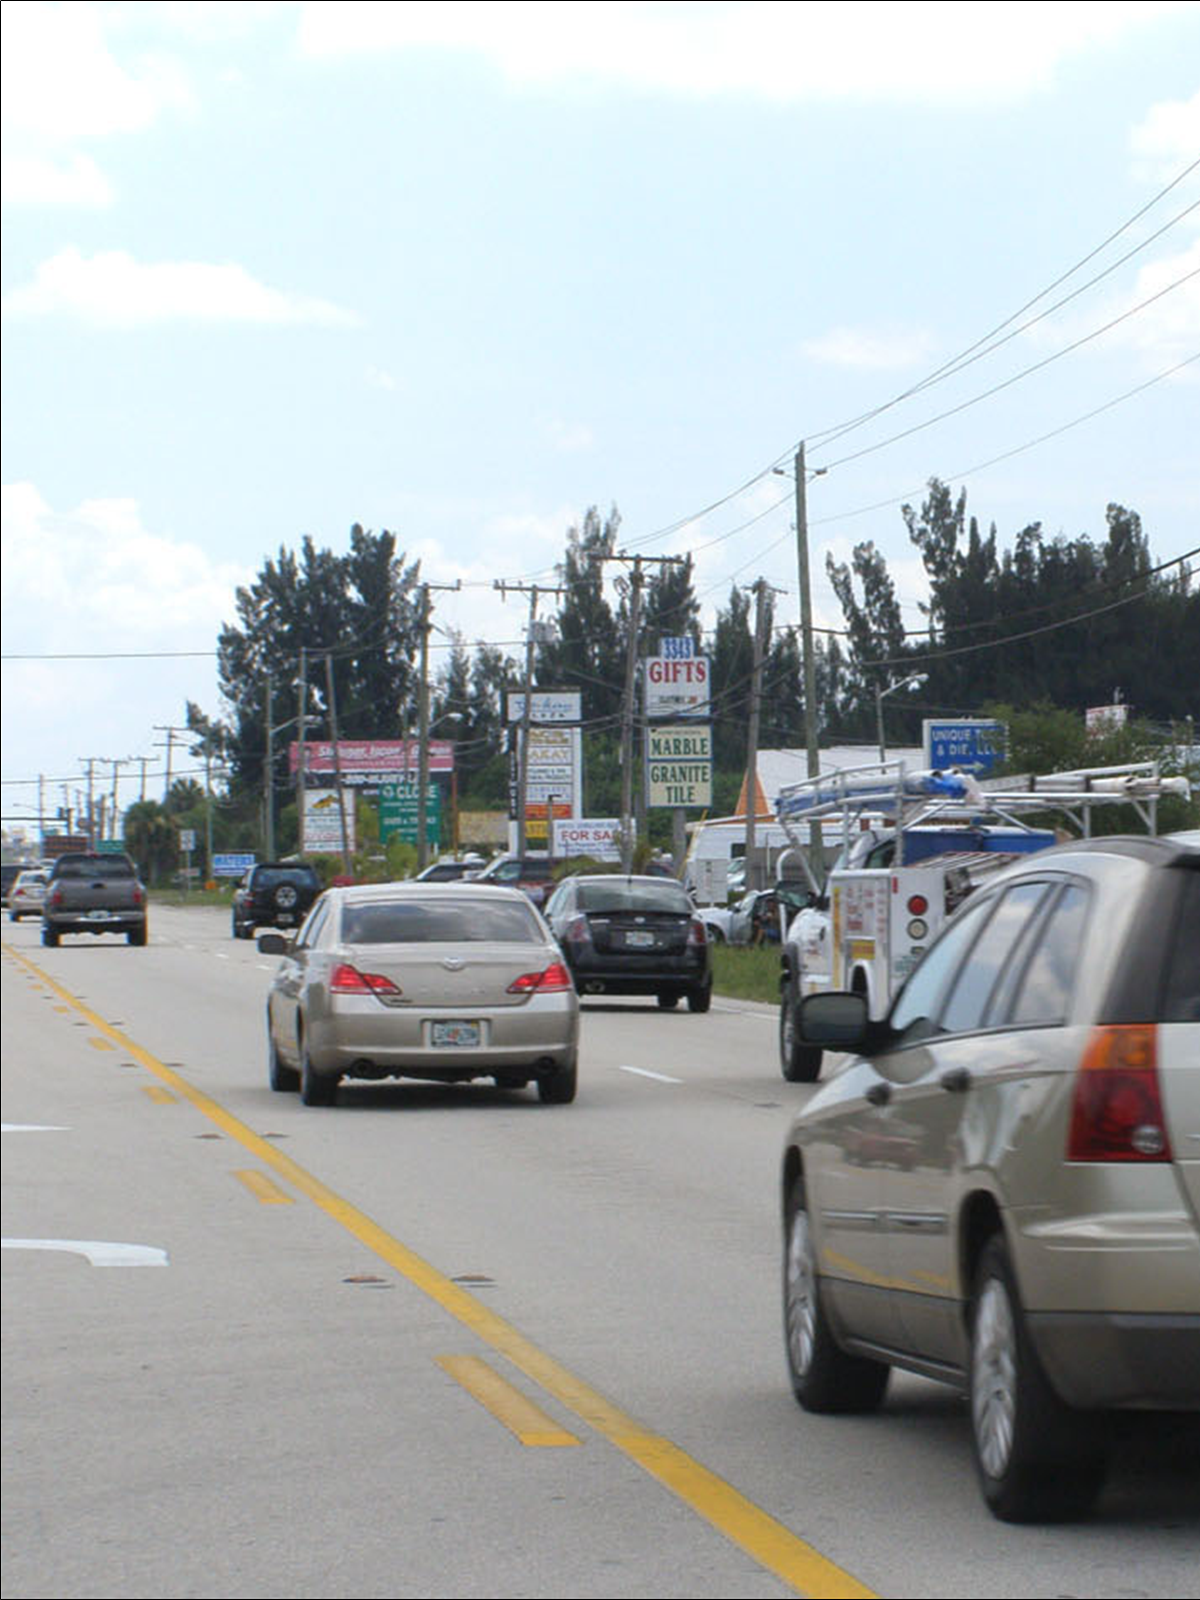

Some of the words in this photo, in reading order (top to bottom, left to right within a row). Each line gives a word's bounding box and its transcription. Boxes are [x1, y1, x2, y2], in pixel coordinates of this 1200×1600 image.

[649, 661, 706, 683] GIFTS
[932, 729, 971, 741] UNIQUE
[651, 738, 709, 755] MARBLE
[651, 766, 709, 783] GRANITE
[665, 786, 695, 804] TILE
[561, 831, 589, 841] FOR
[592, 831, 620, 841] SA
